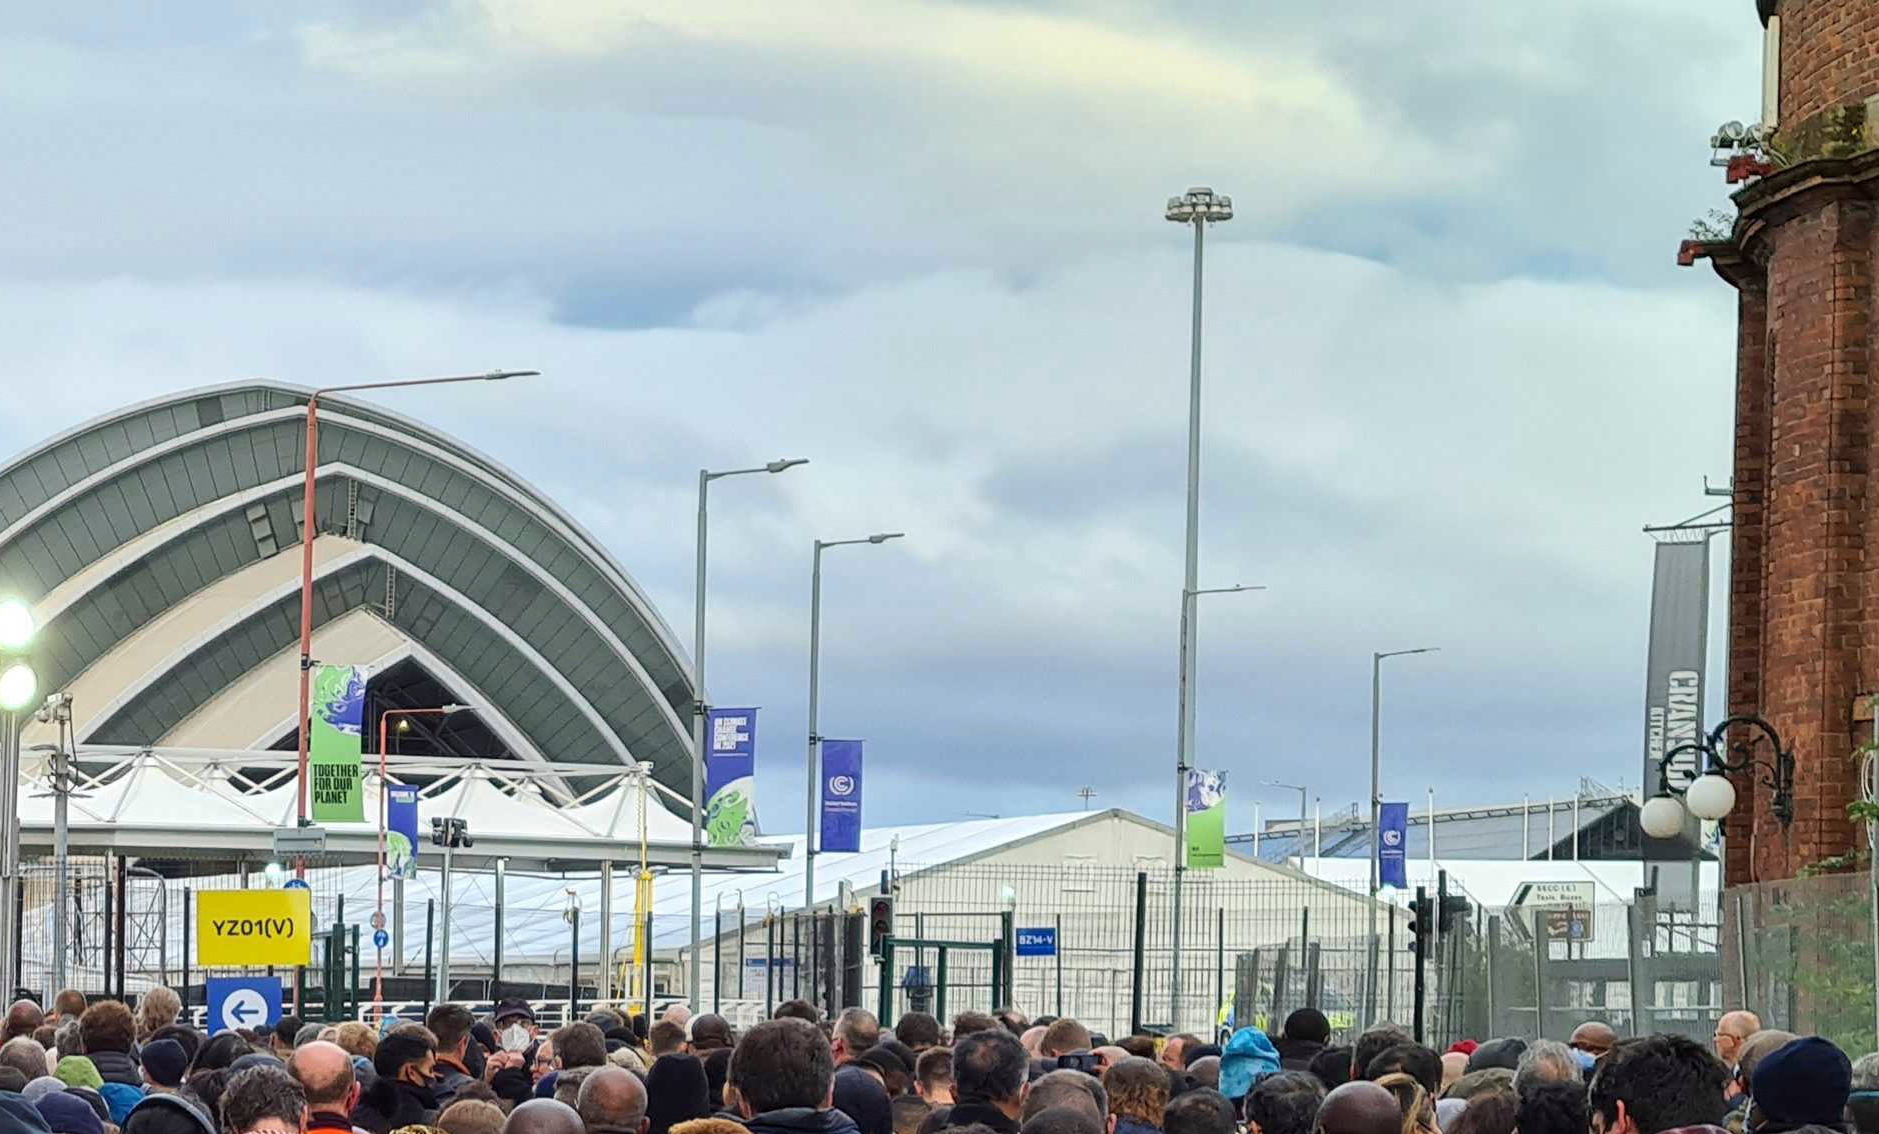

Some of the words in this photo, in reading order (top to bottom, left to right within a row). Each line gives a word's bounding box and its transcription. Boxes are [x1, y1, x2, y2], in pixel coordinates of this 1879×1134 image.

[313, 764, 359, 778] TOGETHER
[314, 778, 333, 791] FOR
[333, 778, 353, 791] OUR
[314, 791, 348, 804] PLANET
[212, 917, 294, 939] YZ01(V)
